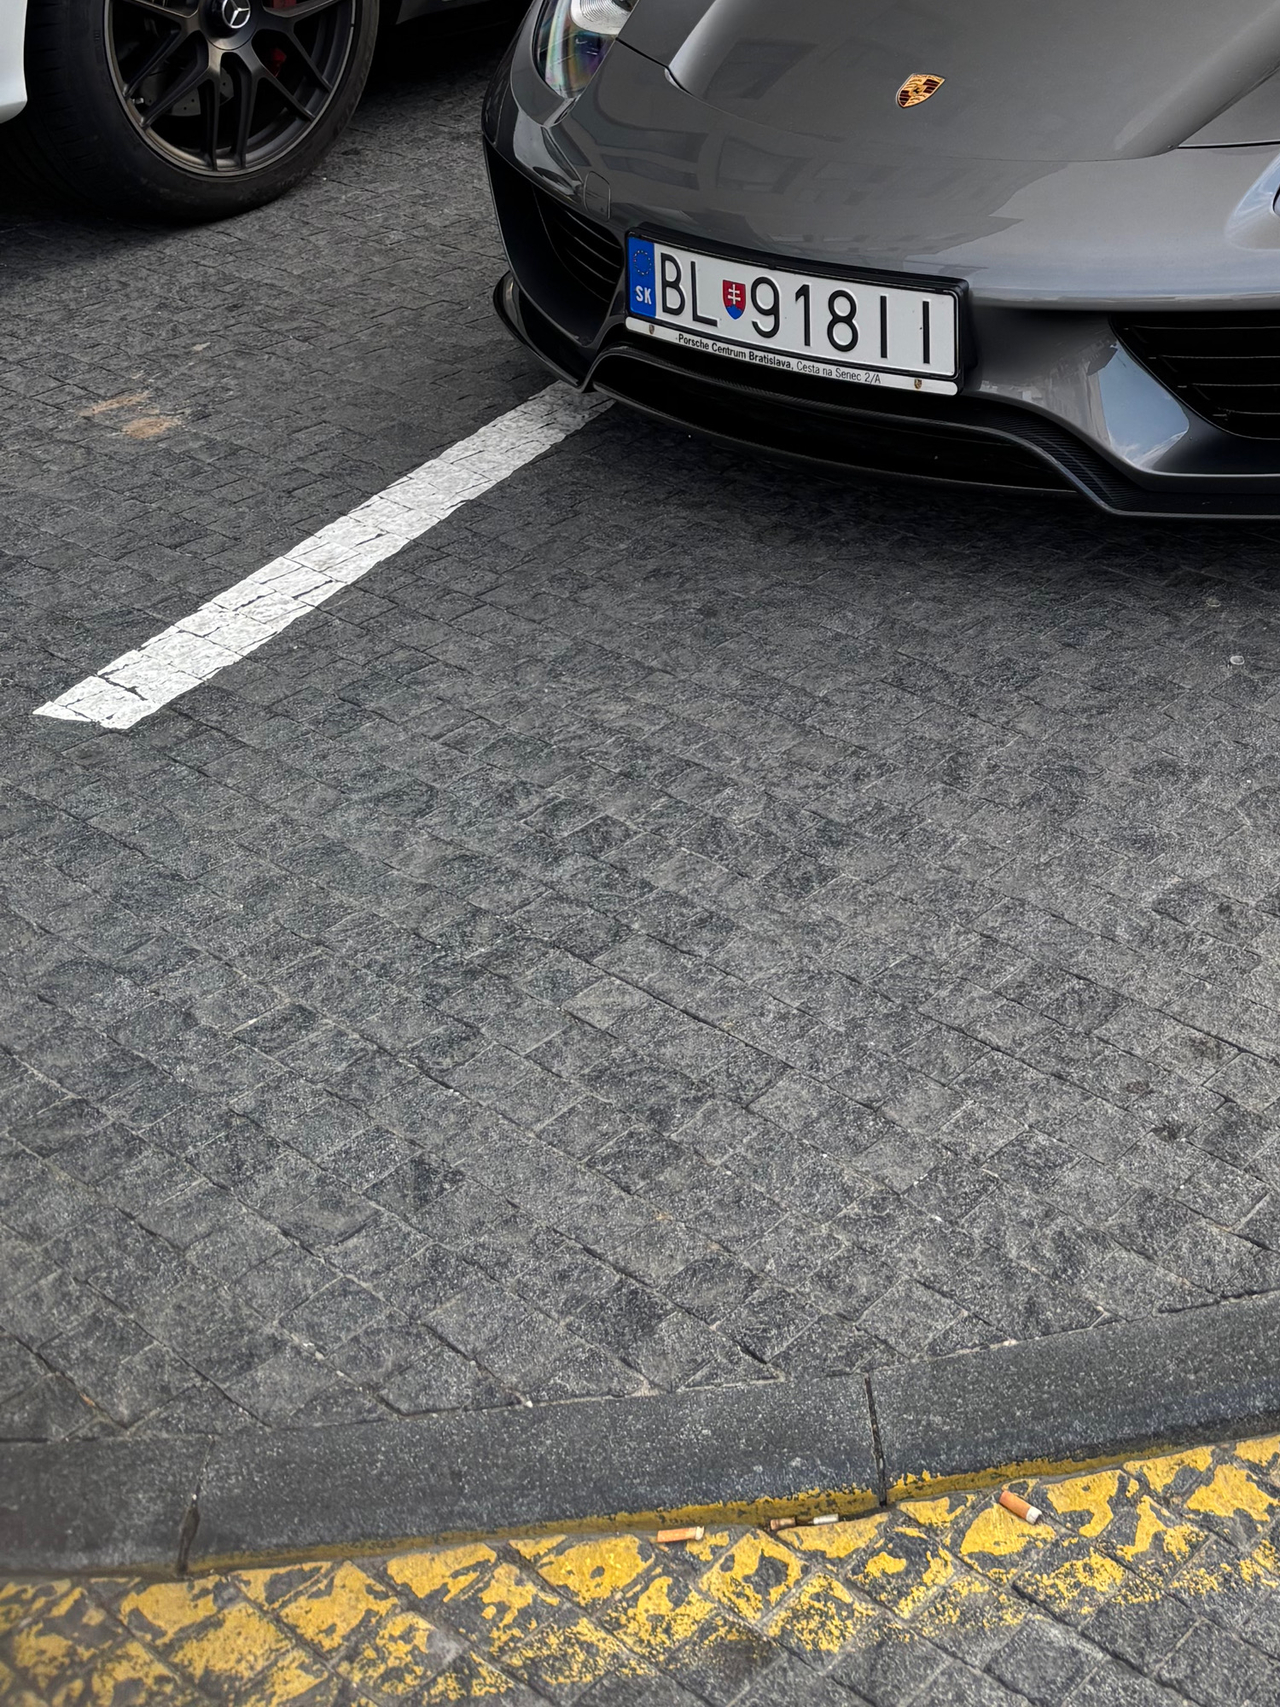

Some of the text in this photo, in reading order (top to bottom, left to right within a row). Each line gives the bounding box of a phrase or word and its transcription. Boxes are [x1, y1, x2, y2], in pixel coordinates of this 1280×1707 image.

[635, 285, 652, 305] SK
[660, 252, 718, 328] BL
[678, 333, 881, 384] Porsche Centrum Bratislava, Cesta na Senec 2/A
